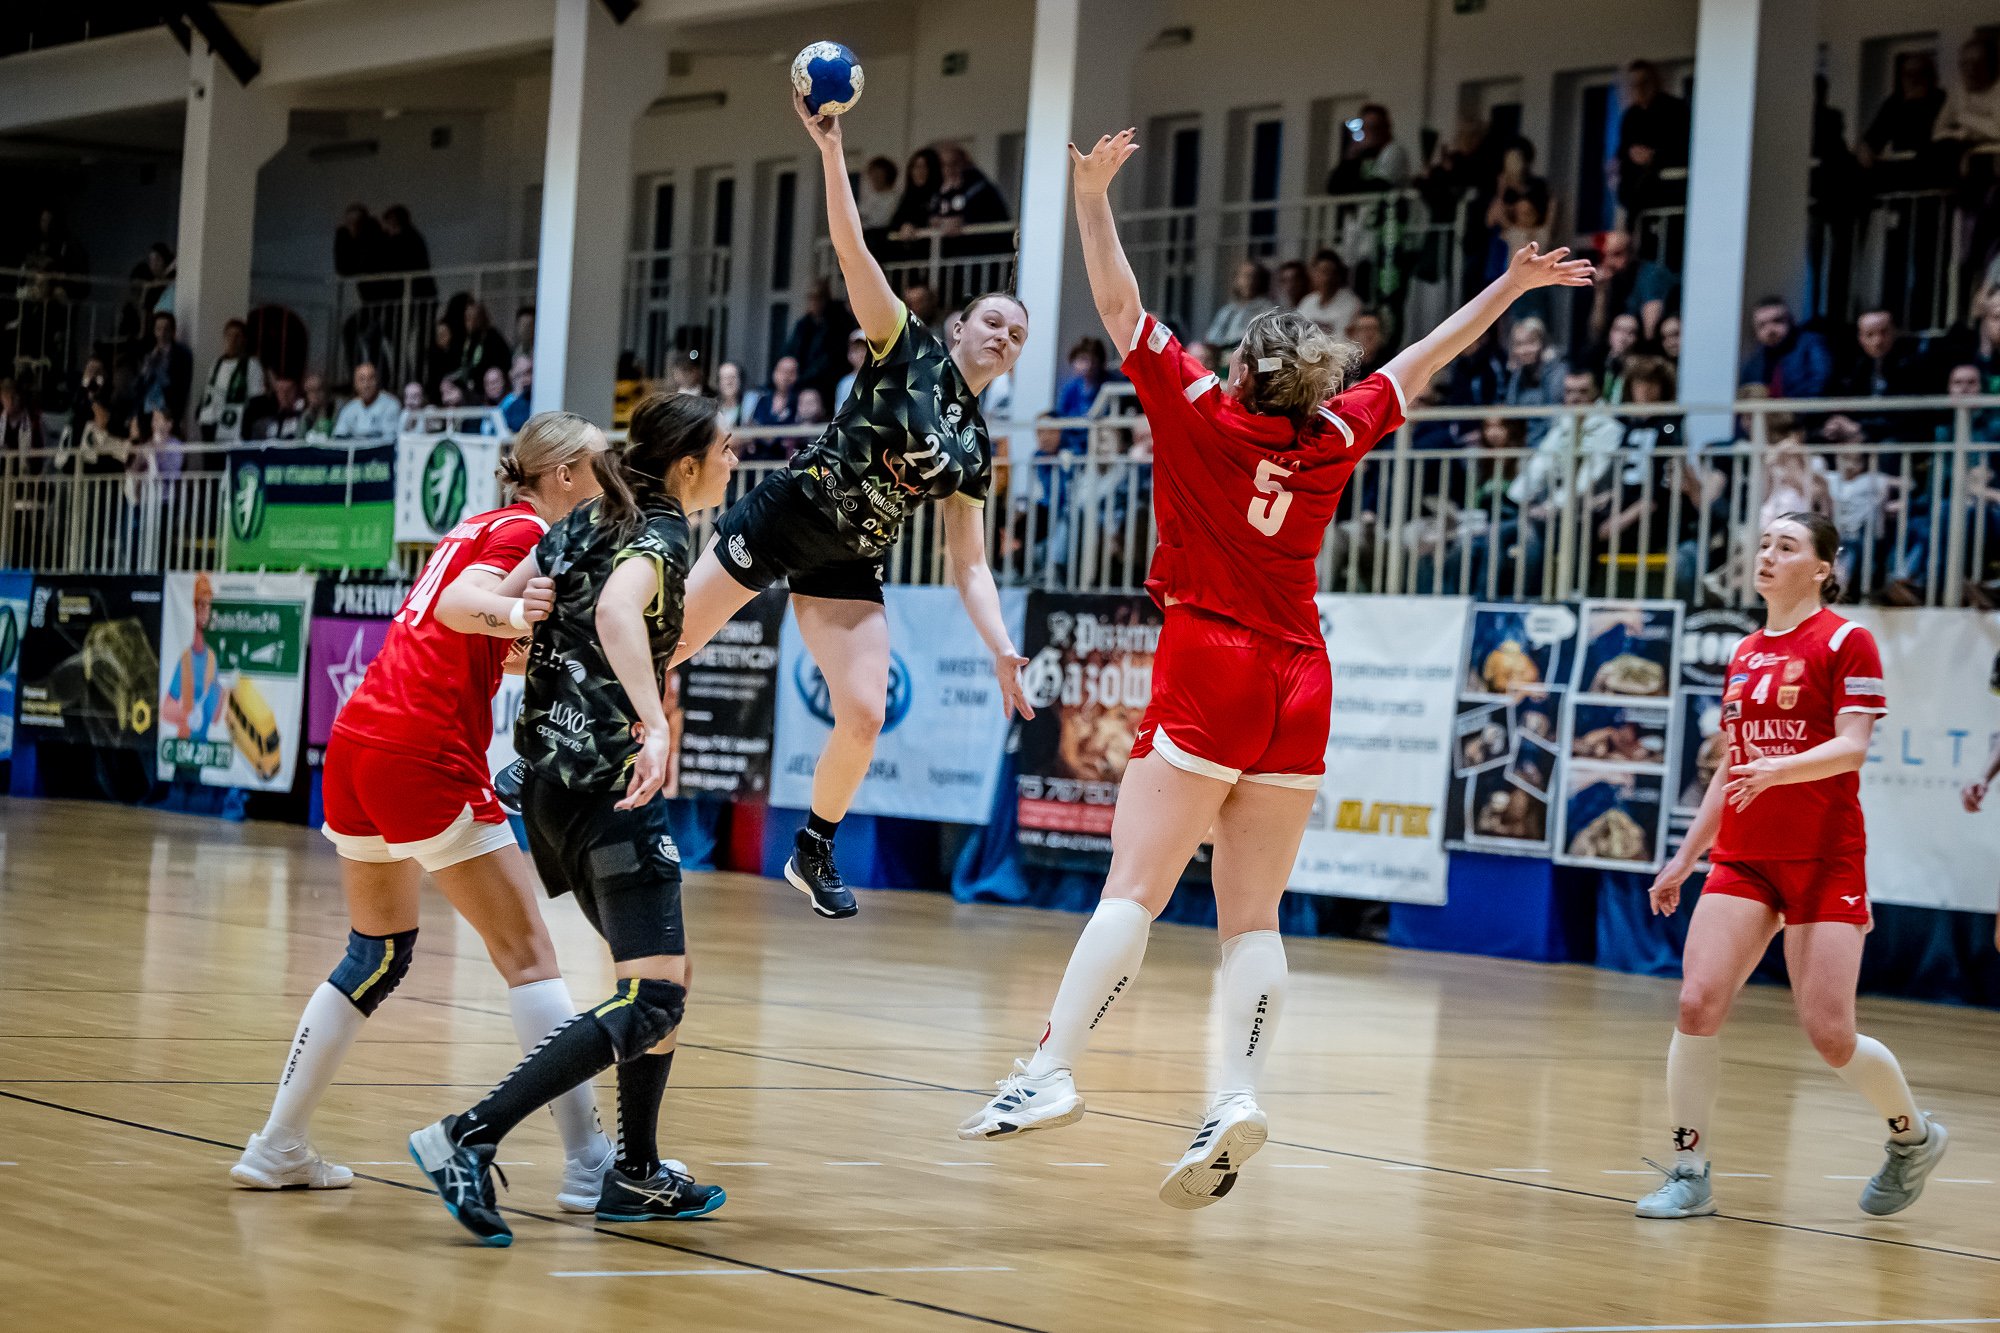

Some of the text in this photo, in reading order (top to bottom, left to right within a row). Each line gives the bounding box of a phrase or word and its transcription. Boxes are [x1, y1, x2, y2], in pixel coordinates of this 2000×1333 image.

[1247, 459, 1293, 537] 5
[1022, 646, 1152, 708] Gazow
[1751, 674, 1773, 705] 4
[1742, 719, 1808, 741] OLKUSZ
[1089, 995, 1115, 1030] OLKUSZ
[1245, 1017, 1264, 1057] OLKUSZ
